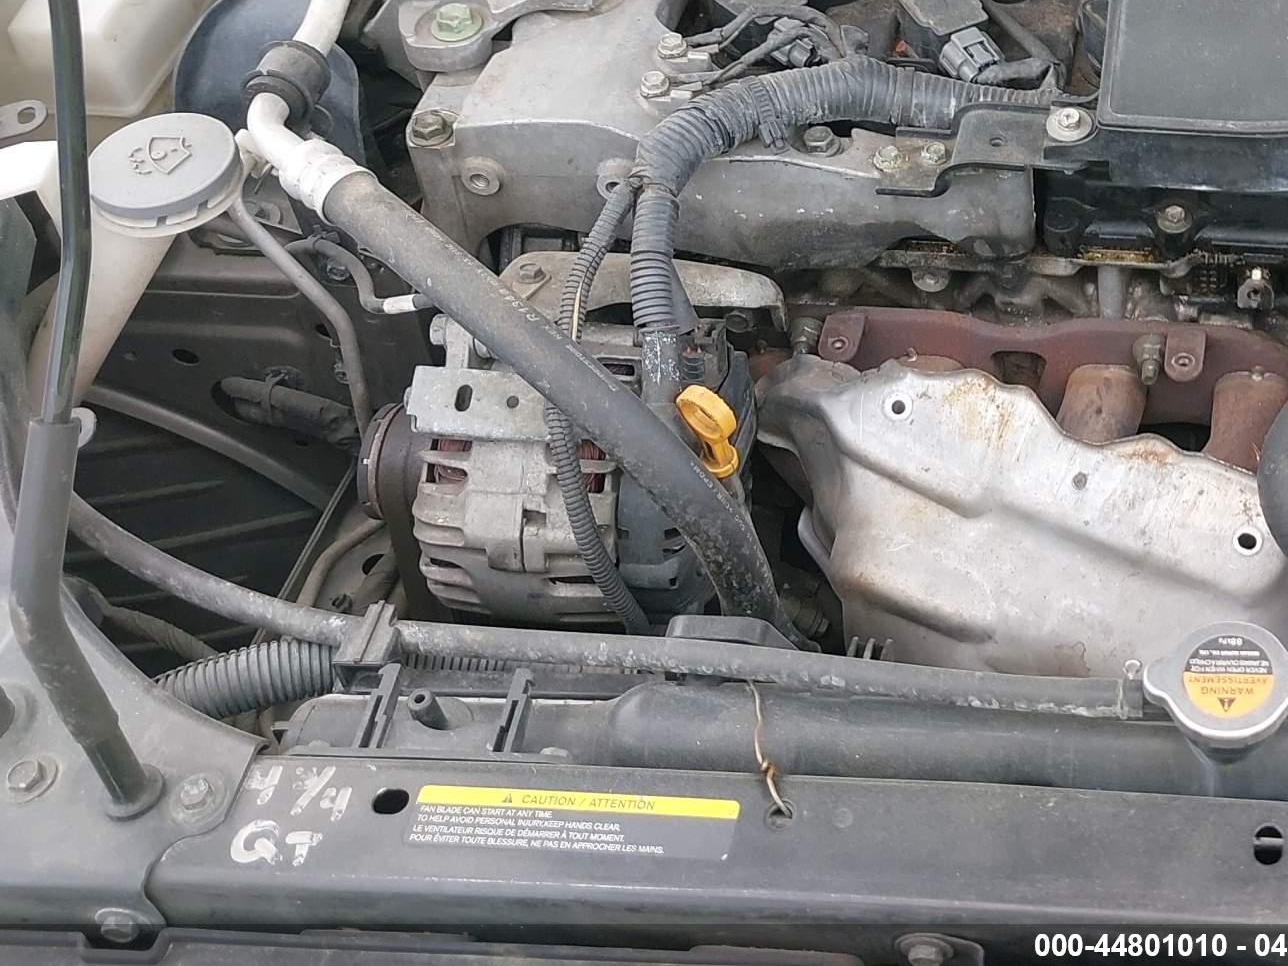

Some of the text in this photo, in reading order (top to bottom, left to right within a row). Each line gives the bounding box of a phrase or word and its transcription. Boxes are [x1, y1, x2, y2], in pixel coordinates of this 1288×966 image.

[1188, 675, 1269, 684] AVERTISSEMENT
[1200, 686, 1254, 695] WARNING
[522, 794, 576, 806] CAUTION
[588, 798, 656, 810] ATTENTION
[420, 805, 436, 813] FAN
[437, 806, 462, 814] BLADE
[481, 807, 506, 816] START
[507, 808, 517, 816] AT
[517, 809, 534, 817] ANY
[417, 814, 428, 822] TO
[429, 814, 449, 822] HELP
[449, 815, 474, 824] AVOID
[475, 817, 516, 826] PERSONAL
[565, 821, 593, 829] HANDS
[412, 824, 423, 832] LE
[423, 825, 474, 835] VENTILATEUR
[475, 827, 504, 836] RISQUE
[505, 828, 517, 836] DE
[517, 827, 560, 839] DÉMARRER
[568, 832, 589, 840] TOUT
[409, 833, 432, 842] POUR
[432, 832, 460, 843] ÉVITER
[461, 836, 486, 844] TOUTE
[530, 839, 542, 847] NE
[542, 840, 559, 848] PAS
[559, 841, 571, 849] EN
[571, 842, 622, 851] APPROCHER
[621, 844, 637, 852] LES
